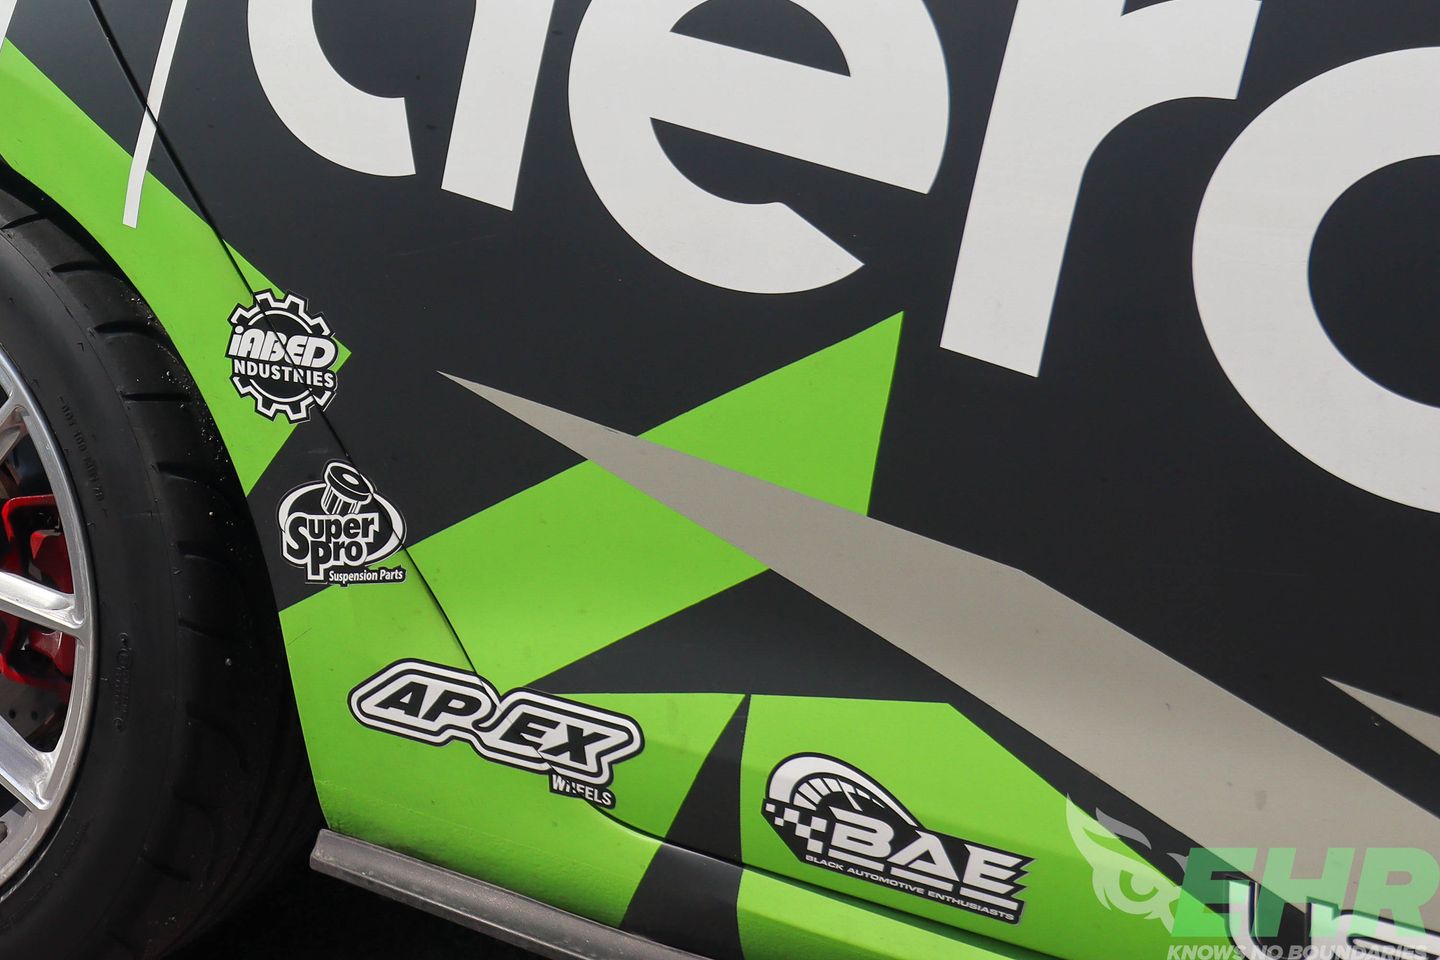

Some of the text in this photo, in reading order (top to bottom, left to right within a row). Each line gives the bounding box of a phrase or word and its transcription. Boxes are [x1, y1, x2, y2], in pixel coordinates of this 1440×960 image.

[287, 514, 380, 562] Super
[328, 568, 403, 583] Suspension Parts
[373, 680, 611, 766] APEX
[827, 806, 1024, 895] BAE
[805, 854, 1016, 922] BLACK AUTOMOTIVE ENTHUSIASTS
